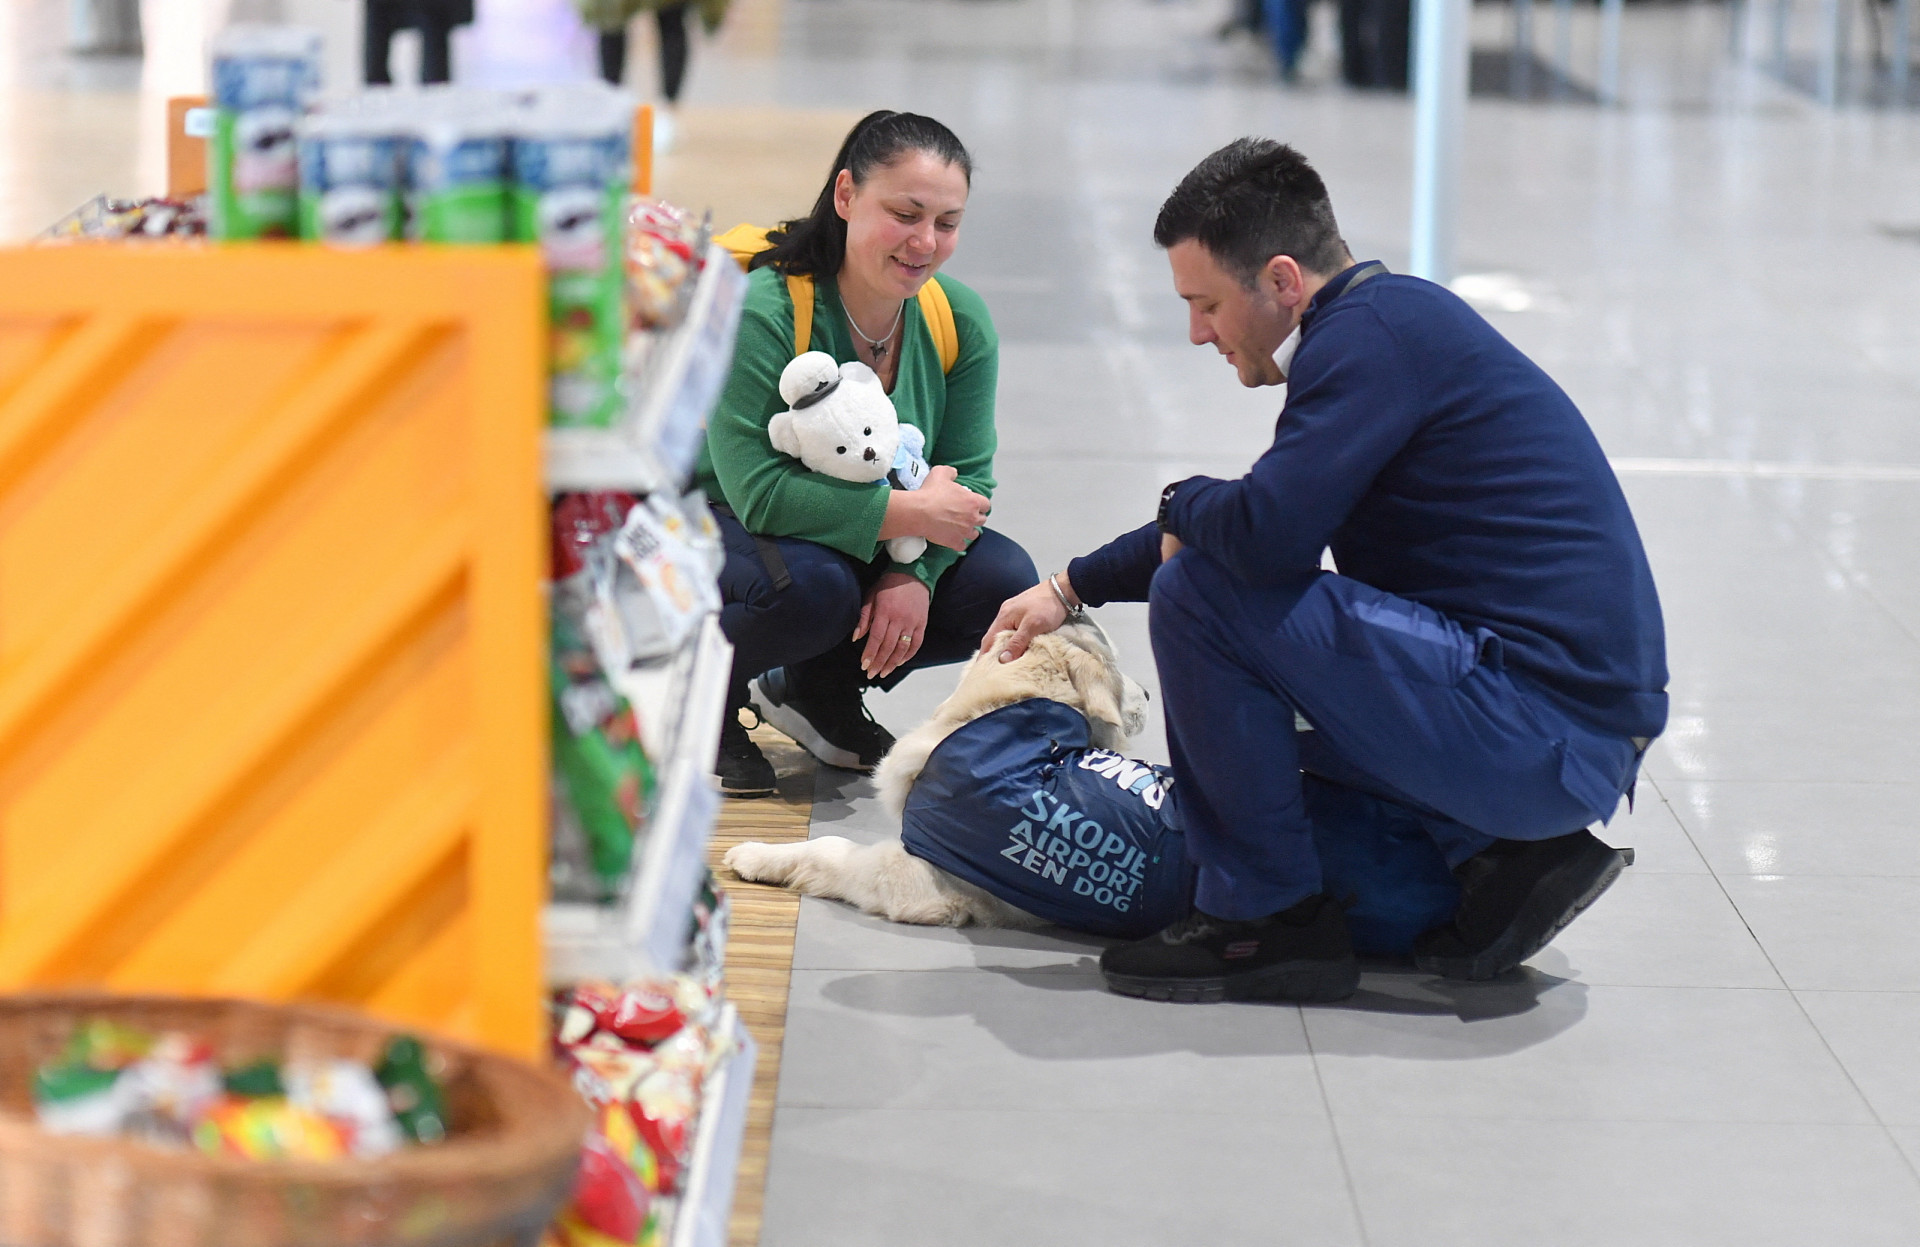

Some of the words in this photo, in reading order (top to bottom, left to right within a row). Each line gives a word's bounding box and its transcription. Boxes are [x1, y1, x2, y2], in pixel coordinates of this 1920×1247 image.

[1010, 820, 1143, 896] AIRPORT
[1021, 790, 1147, 879] SKOPJE
[1000, 835, 1068, 885] ZEN
[1073, 876, 1131, 913] DOG
